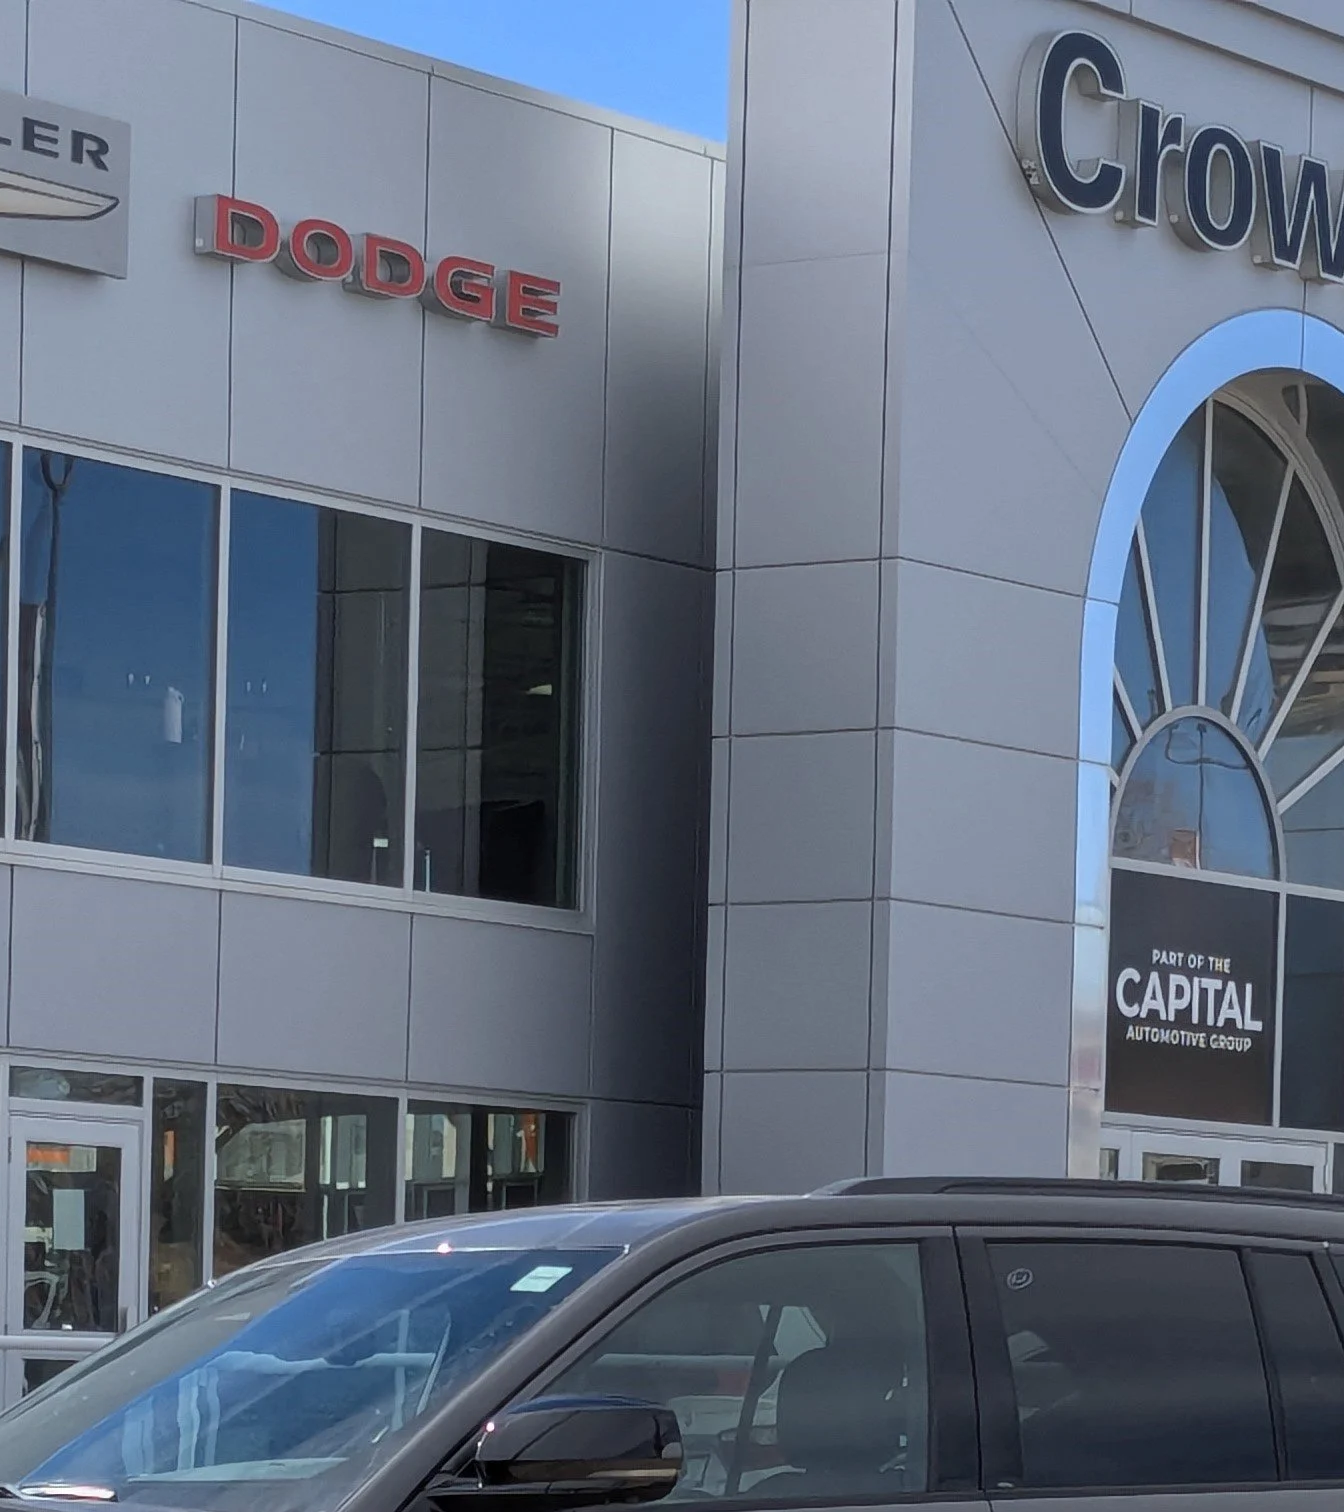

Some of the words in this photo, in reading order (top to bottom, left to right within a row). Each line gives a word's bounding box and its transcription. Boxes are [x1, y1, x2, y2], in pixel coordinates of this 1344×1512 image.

[209, 193, 560, 339] DODGE
[1152, 949, 1184, 966] PART
[1187, 953, 1205, 970] OF
[1208, 956, 1231, 973] THE
[1115, 967, 1263, 1032] CAPITAL
[1126, 1025, 1206, 1047] AUTOMOTIVE
[1209, 1035, 1252, 1052] GROUP
